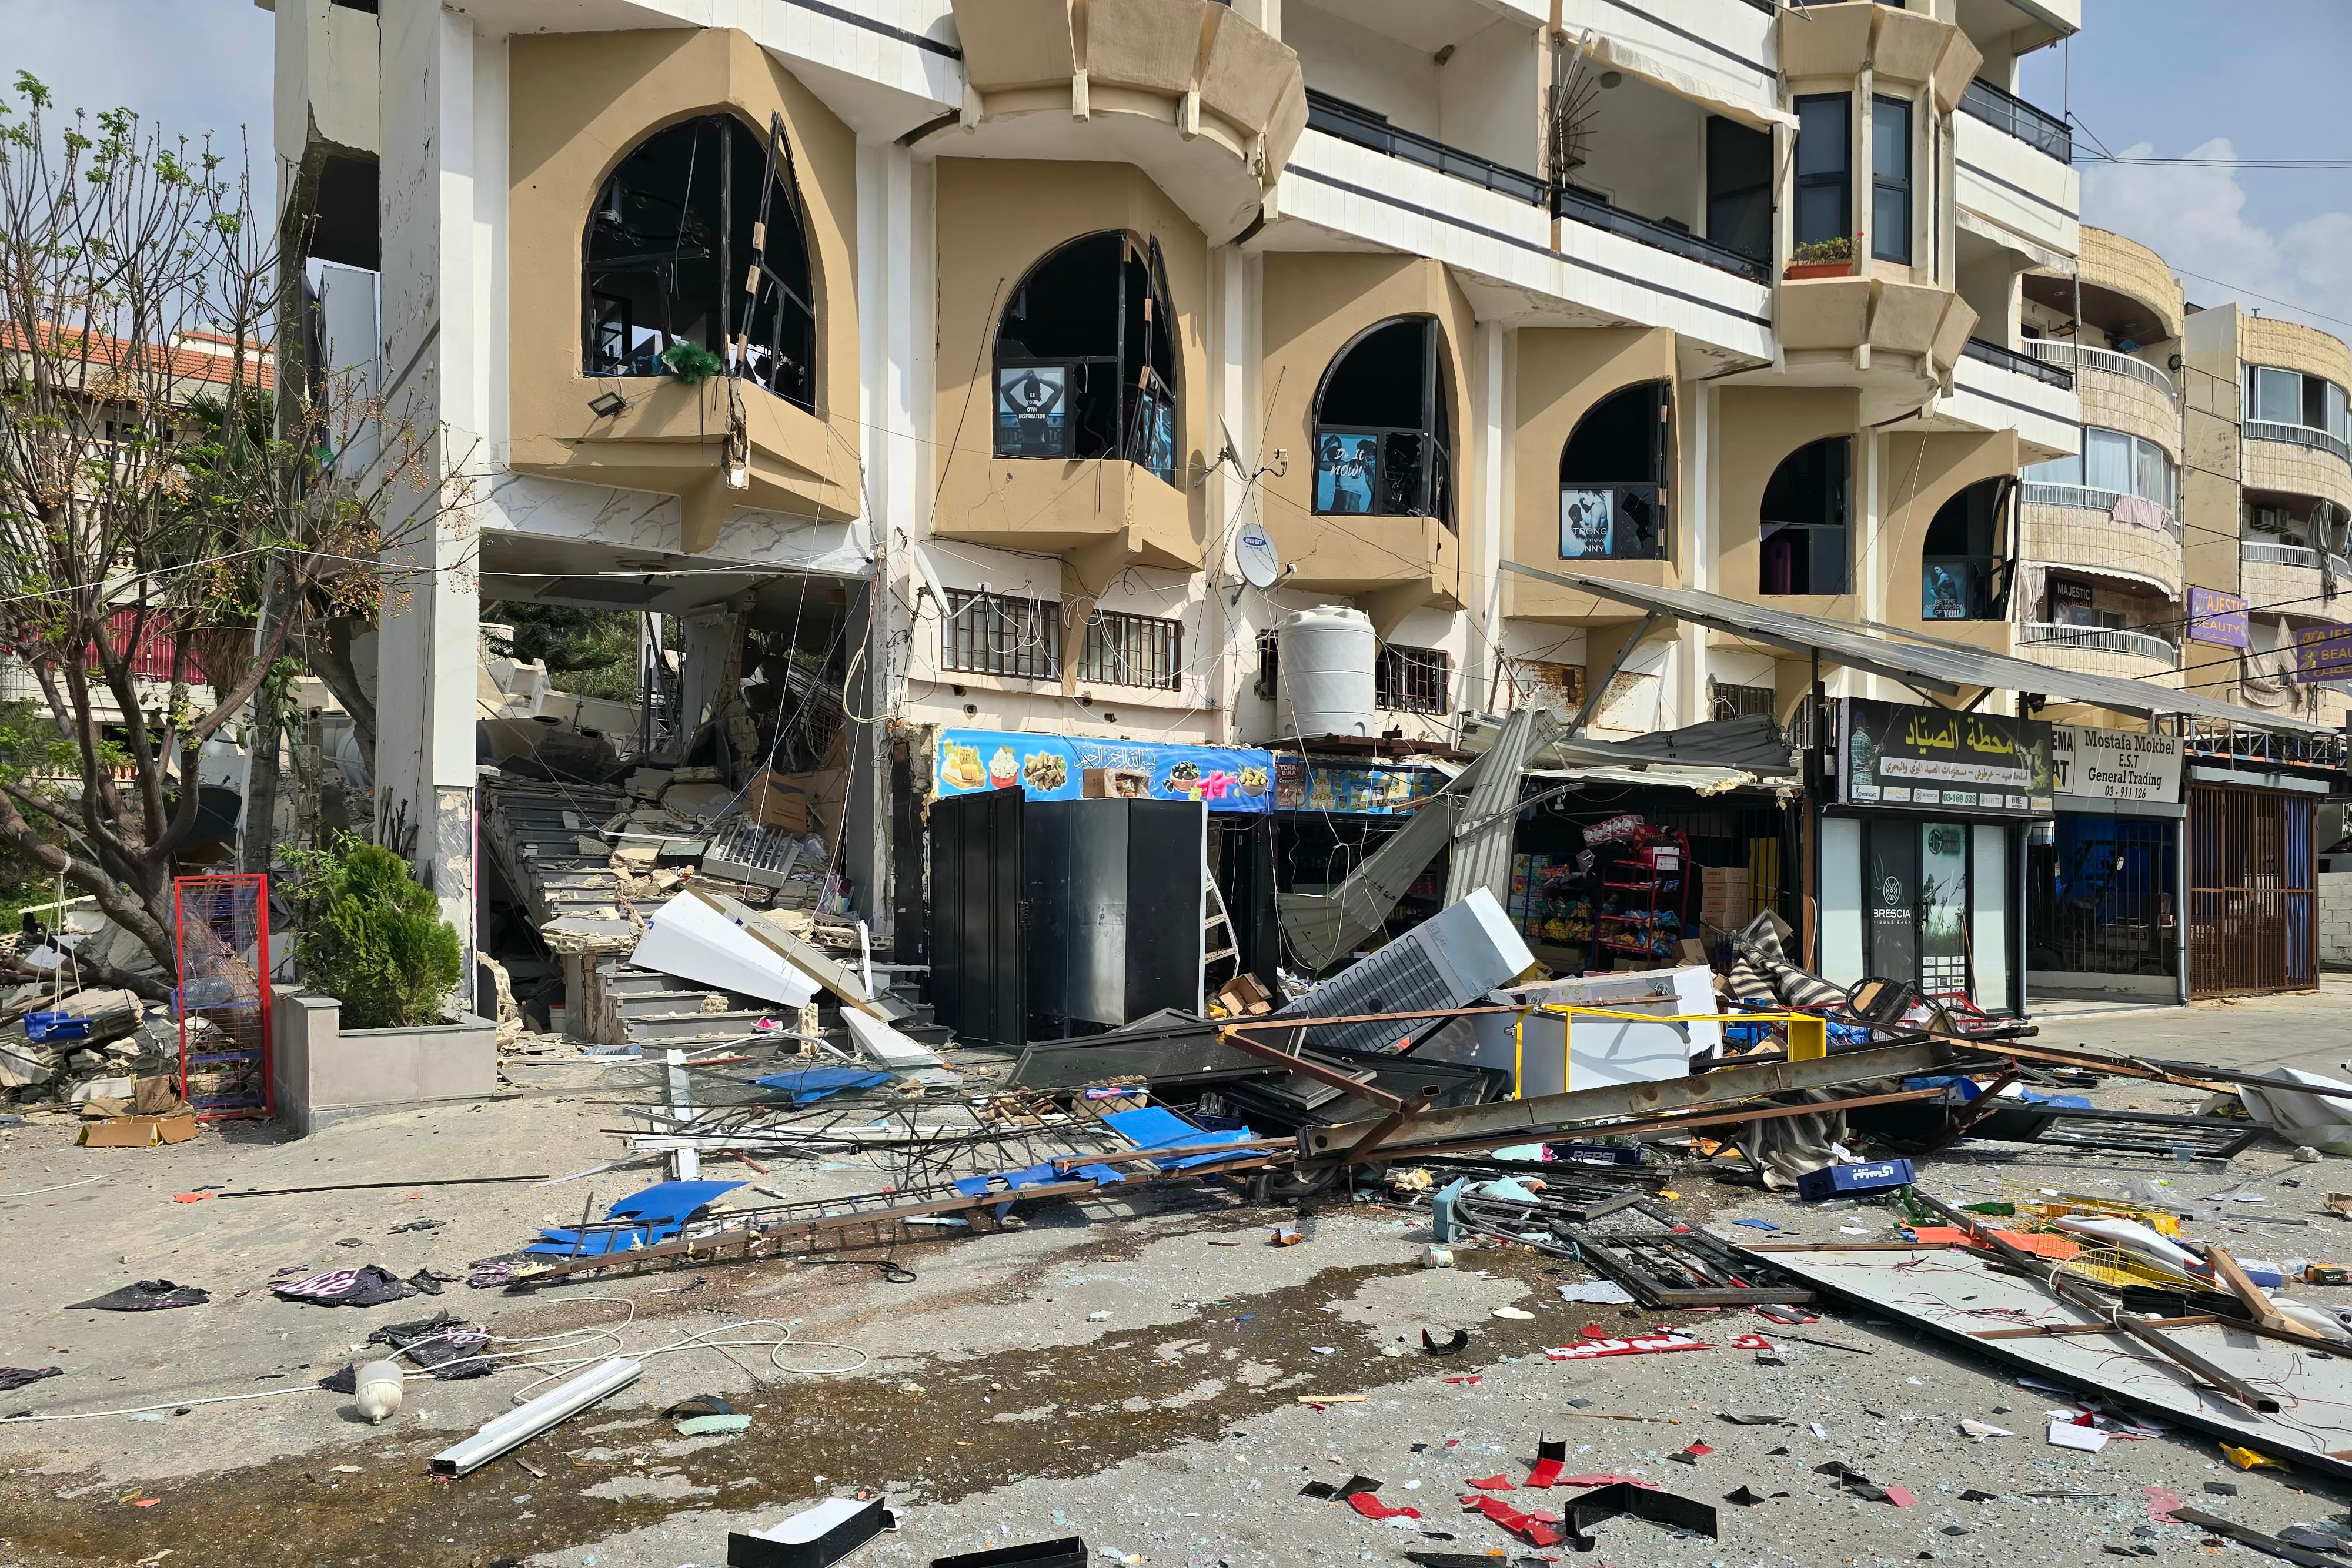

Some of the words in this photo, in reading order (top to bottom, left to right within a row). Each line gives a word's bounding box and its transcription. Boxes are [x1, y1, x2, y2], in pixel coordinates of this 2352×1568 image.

[1334, 448, 1350, 460] Do
[1351, 449, 1365, 460] It
[1569, 544, 1605, 553] SKNNY
[2057, 583, 2090, 600] MAJESTIC
[1967, 716, 2013, 754] محطة
[2084, 730, 2132, 751] Mostafa
[2134, 735, 2174, 755] Mokbel
[2119, 753, 2139, 768] E.S.T
[2088, 767, 2126, 784] General
[2128, 770, 2162, 790] Trading
[1943, 794, 1964, 803] 03-189
[2104, 785, 2113, 797] 03
[2120, 787, 2132, 797] 911
[2135, 787, 2146, 799] 126
[1573, 1151, 1616, 1162] PEPSI
